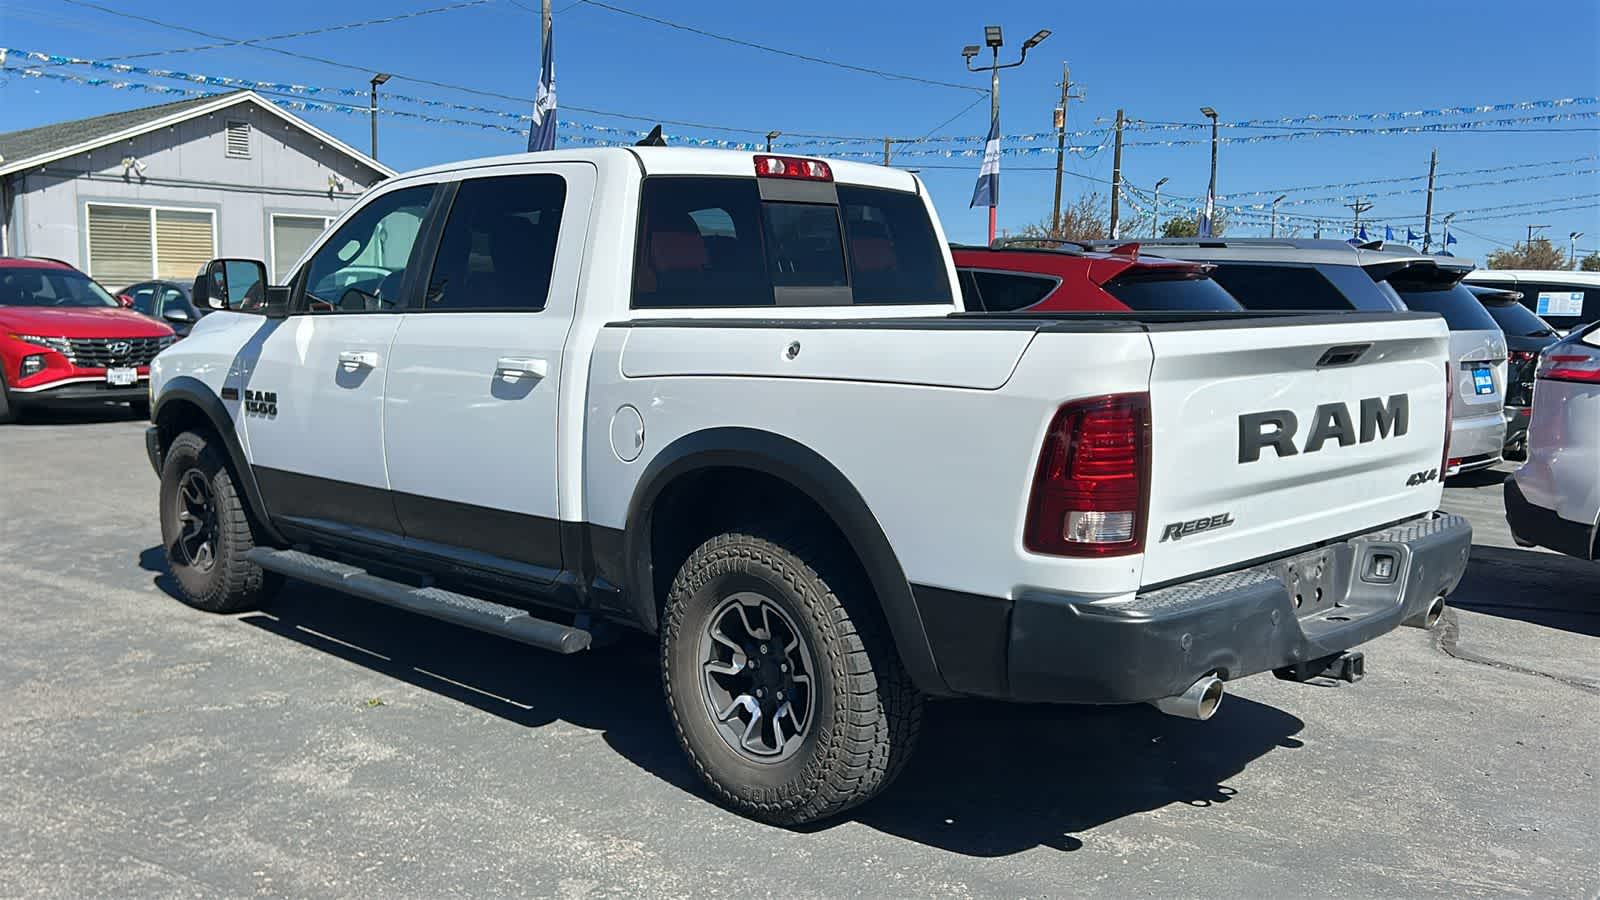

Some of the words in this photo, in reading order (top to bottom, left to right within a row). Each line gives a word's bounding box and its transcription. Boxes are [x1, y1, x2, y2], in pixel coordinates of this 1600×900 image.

[244, 390, 277, 402] RAM
[245, 401, 277, 416] 1500
[1238, 393, 1409, 464] RAM
[1158, 512, 1235, 542] REBEL
